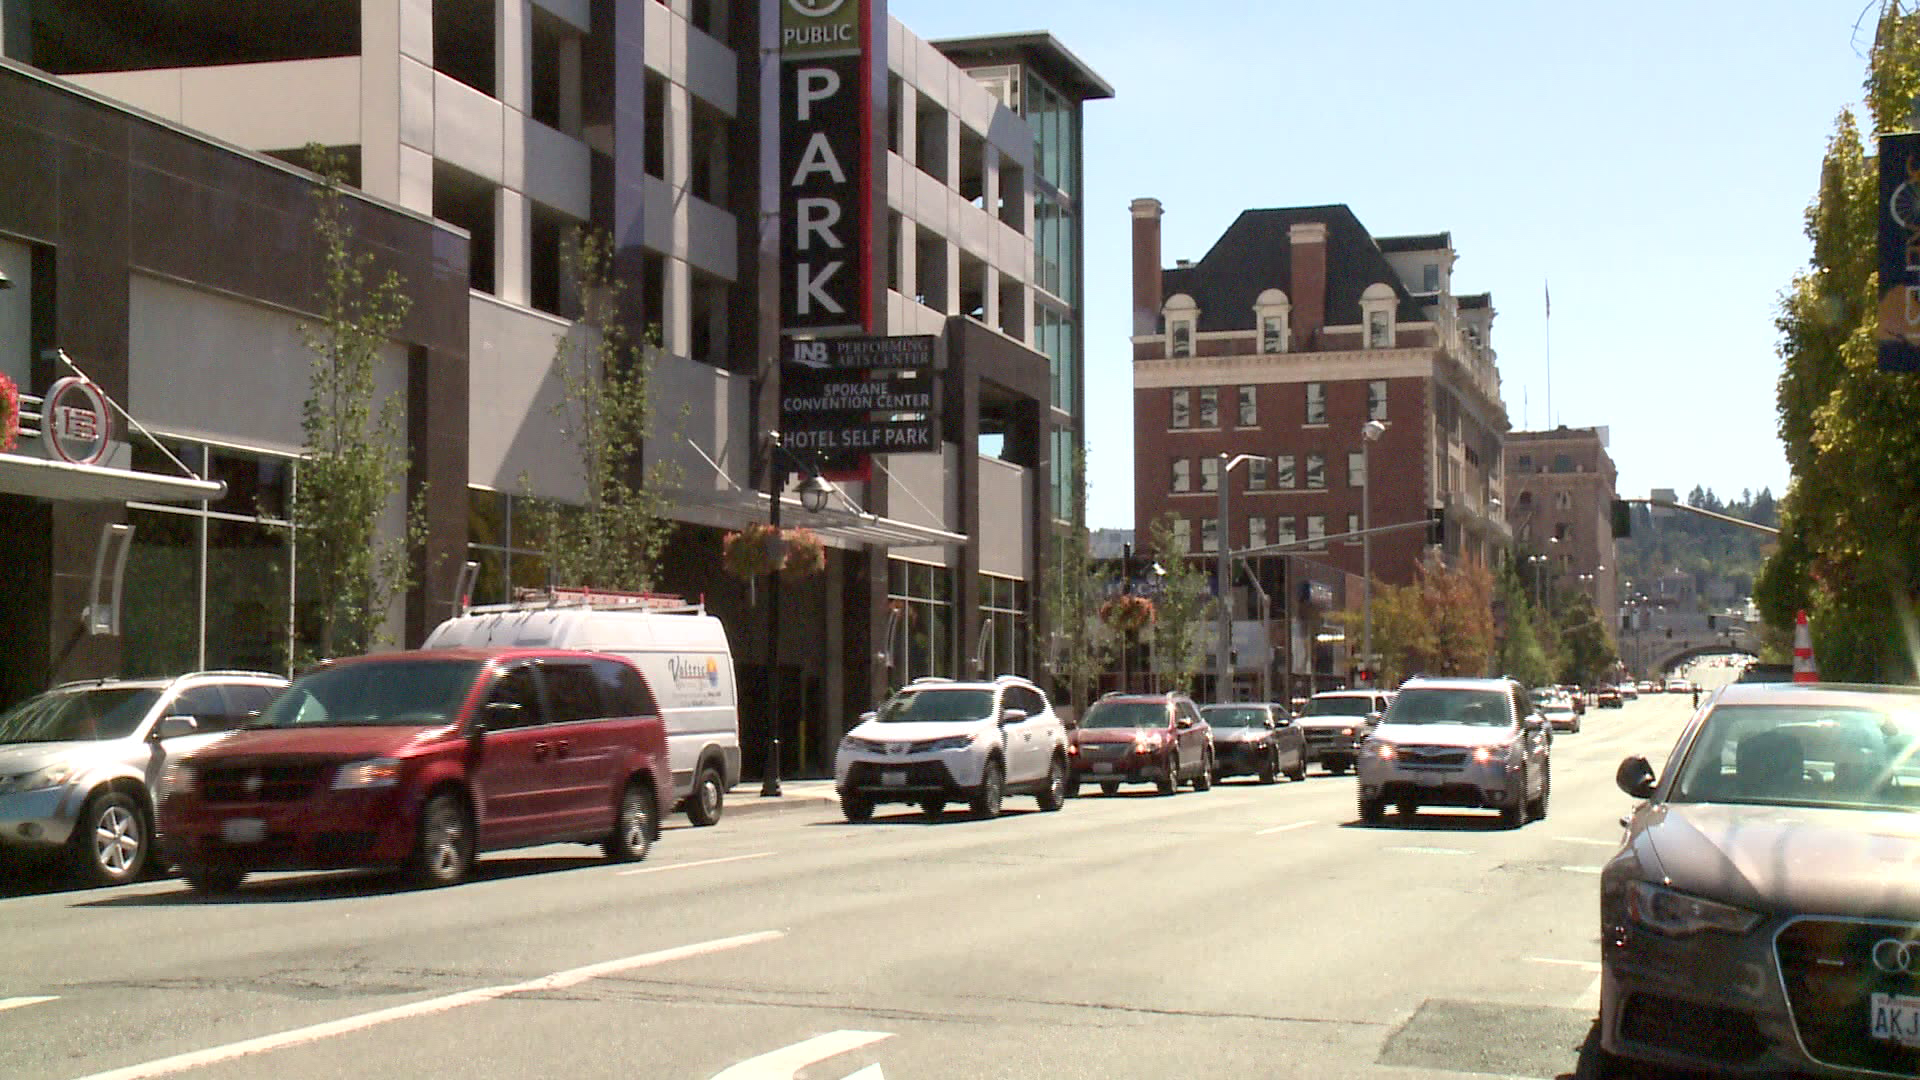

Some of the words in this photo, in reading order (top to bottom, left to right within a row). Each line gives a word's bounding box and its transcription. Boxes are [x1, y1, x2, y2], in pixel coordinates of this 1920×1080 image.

[783, 24, 852, 45] PUBLIC
[791, 67, 847, 315] PARK
[794, 341, 829, 362] INB
[824, 382, 888, 397] SPOKANE
[783, 396, 872, 412] CONVENTION
[877, 393, 929, 408] CENTER
[783, 430, 837, 449] HOTEL
[841, 428, 881, 446] SELF
[885, 427, 929, 446] PARK
[1874, 1007, 1919, 1036] AKJ
